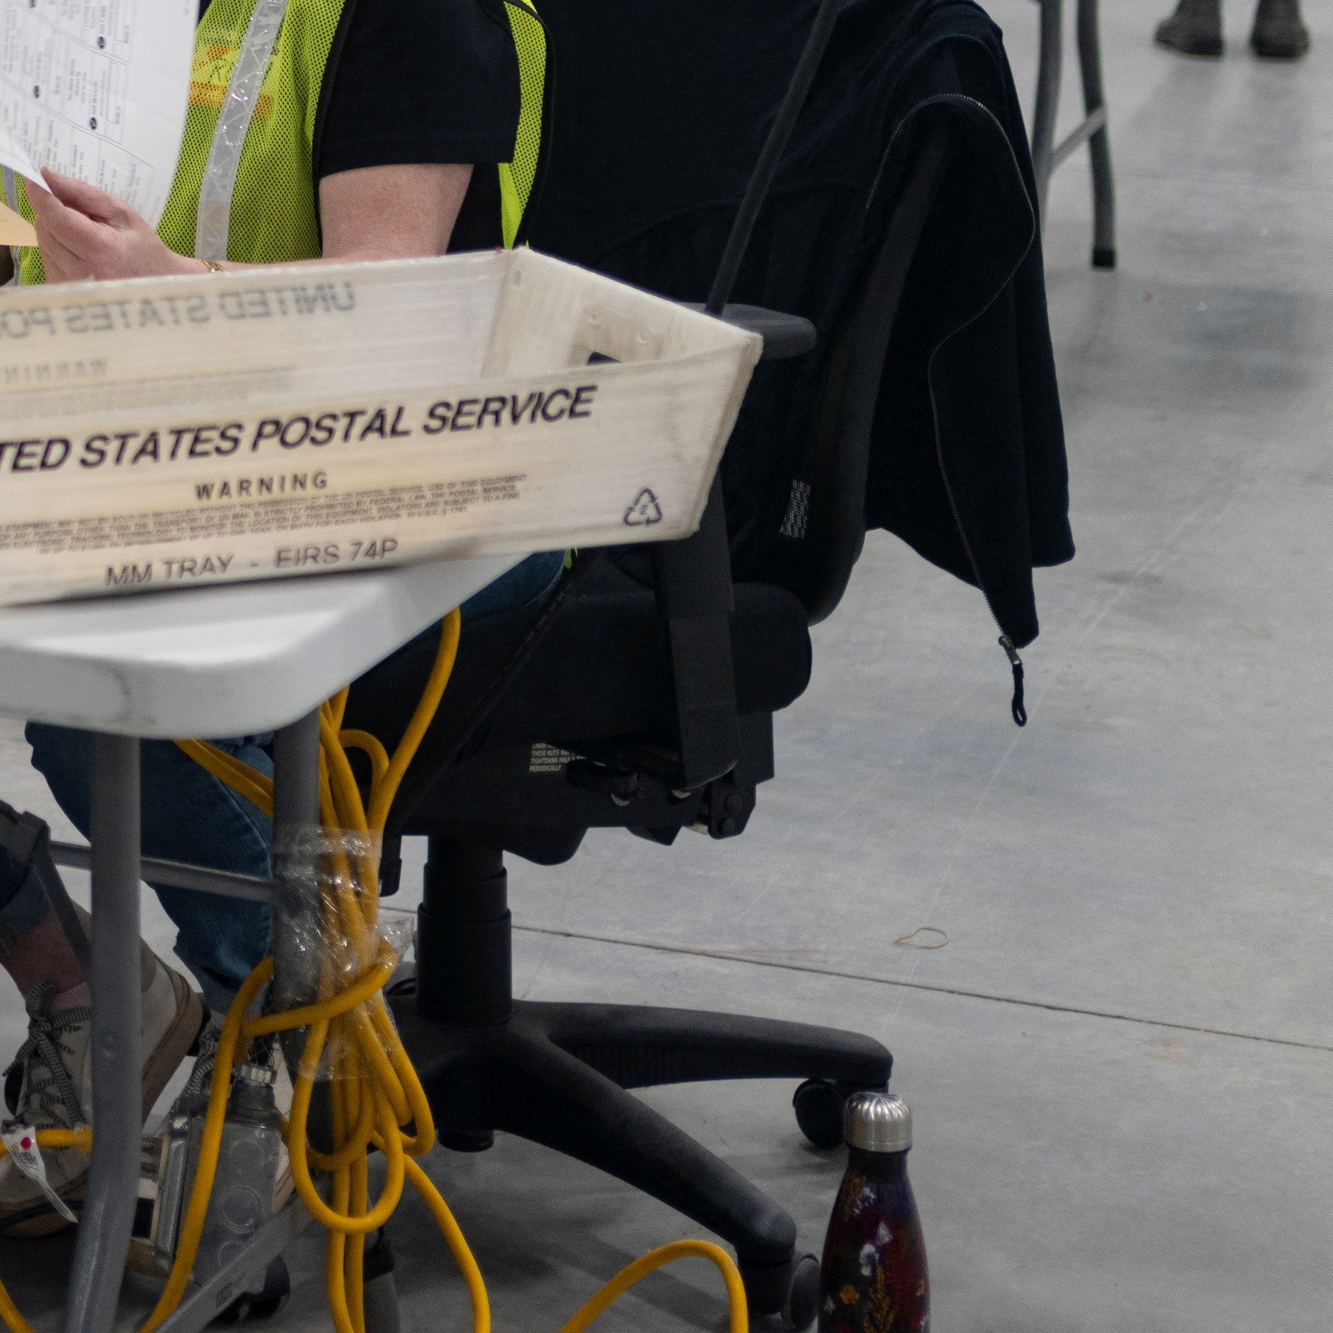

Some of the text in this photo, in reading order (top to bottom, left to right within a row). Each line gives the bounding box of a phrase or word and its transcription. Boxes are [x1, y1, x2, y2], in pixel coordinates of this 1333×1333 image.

[79, 421, 245, 470] STATES
[251, 405, 414, 453] POSTAL
[423, 383, 600, 437] SERVICE
[195, 471, 328, 502] WARNING
[449, 488, 481, 498] POSTAL
[247, 516, 286, 527] LOCATION
[377, 502, 423, 514] VIOLATORS
[443, 496, 480, 507] SUBJECT
[105, 563, 153, 588] MM
[163, 554, 235, 582] TRAY
[351, 538, 399, 560] 74P
